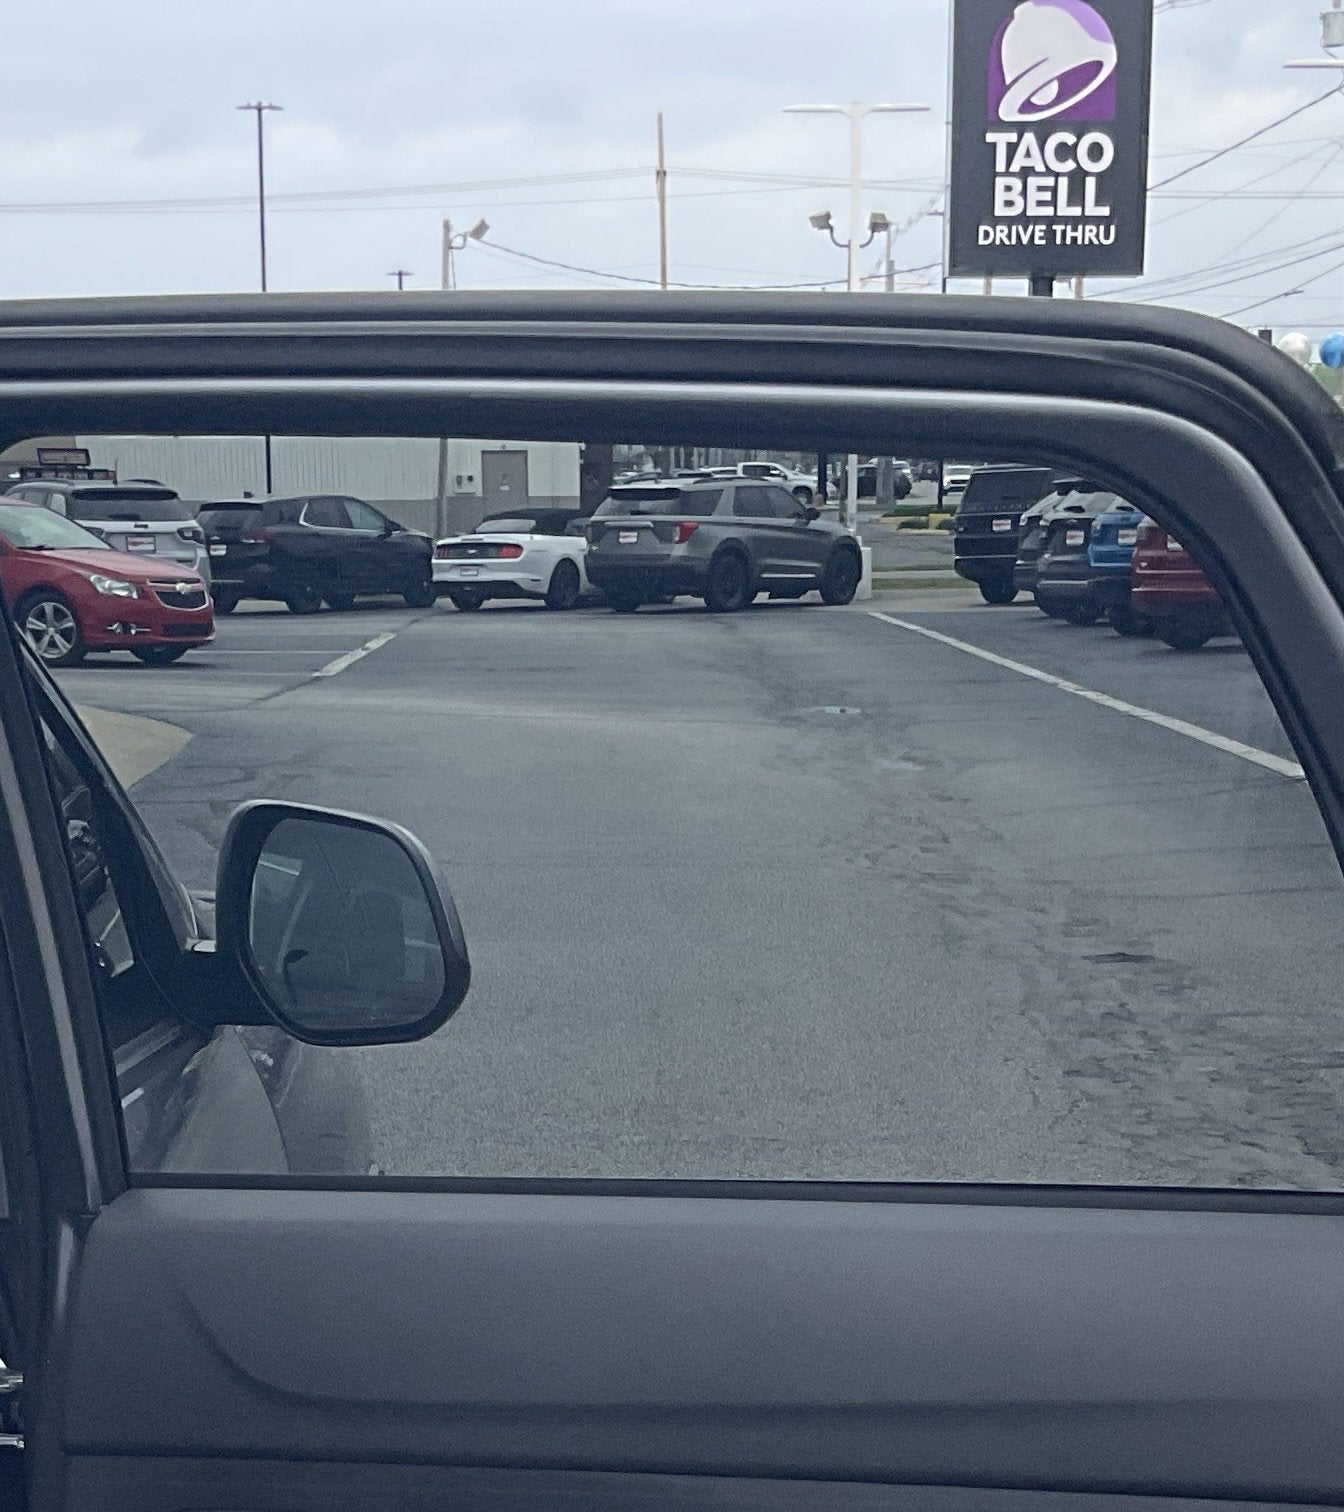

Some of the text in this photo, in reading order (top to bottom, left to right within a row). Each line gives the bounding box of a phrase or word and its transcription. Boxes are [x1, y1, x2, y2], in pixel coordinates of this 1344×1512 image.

[985, 131, 1114, 172] TACO
[994, 176, 1110, 217] BELL
[977, 224, 1116, 246] DRIVE THRU
